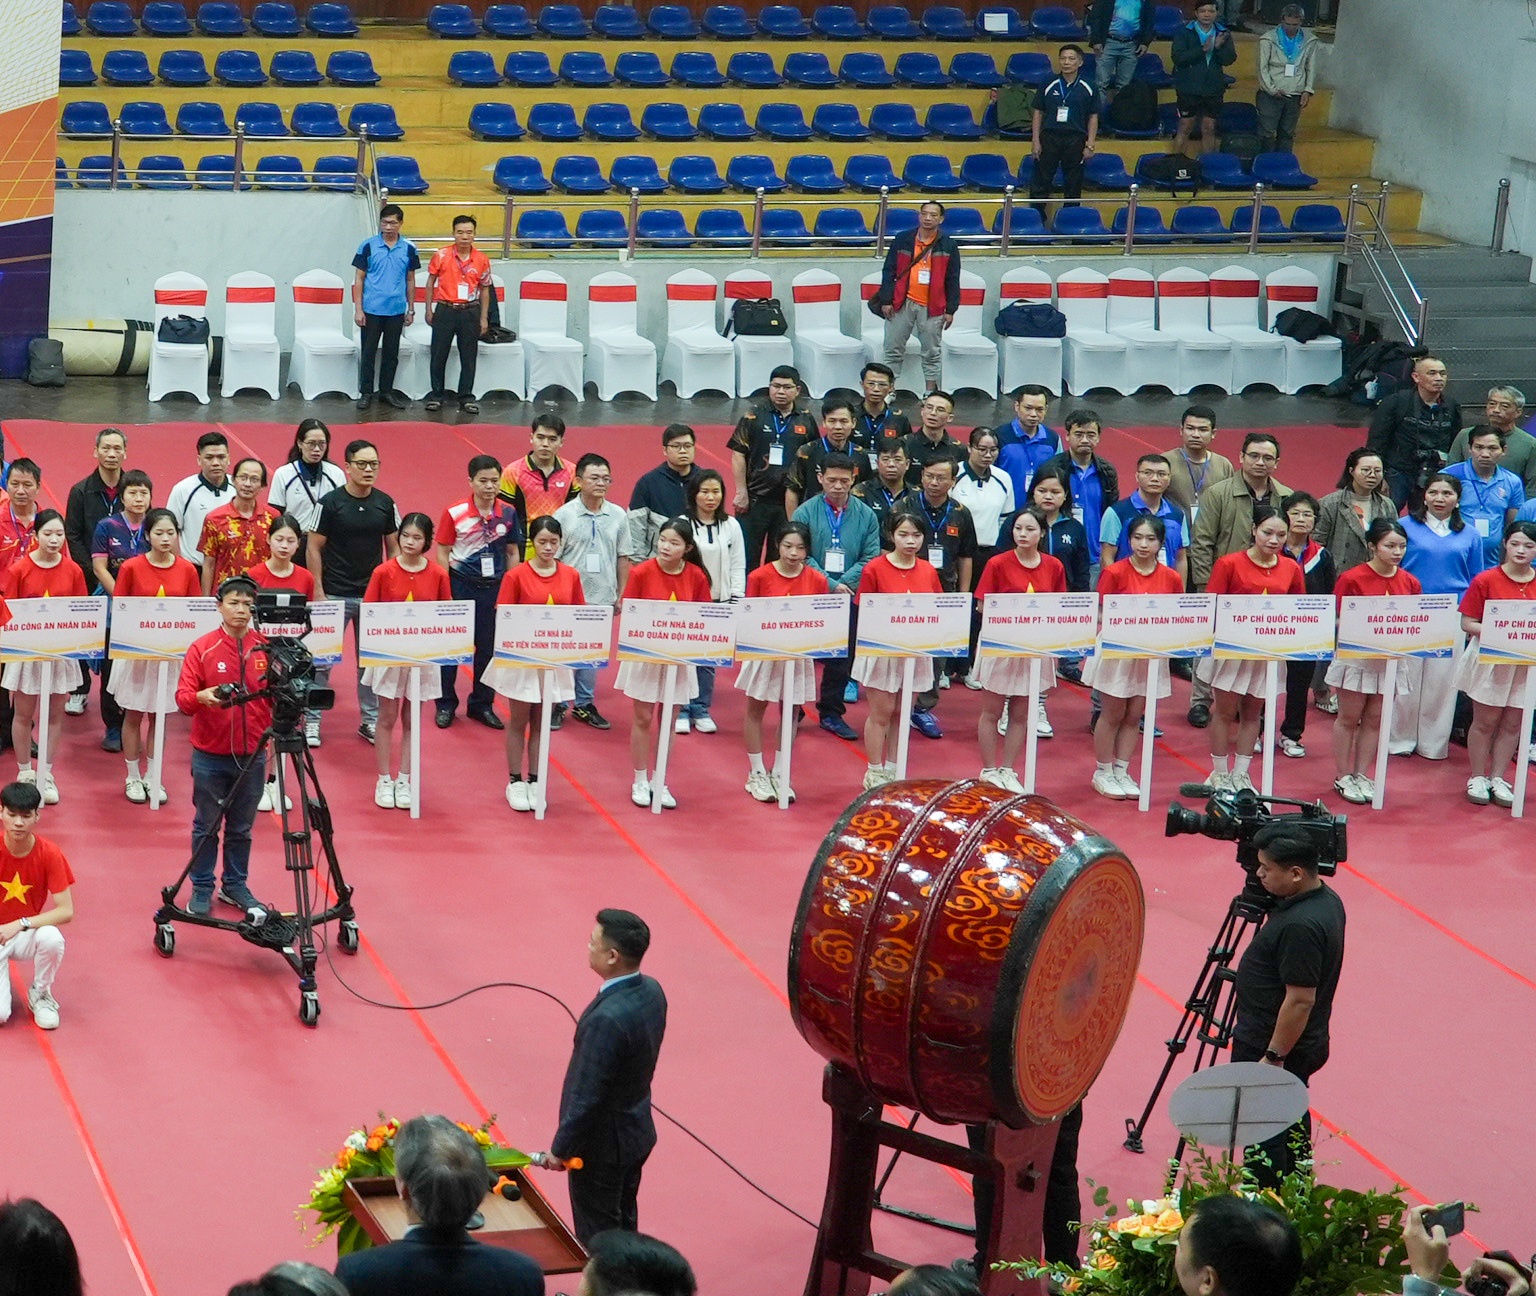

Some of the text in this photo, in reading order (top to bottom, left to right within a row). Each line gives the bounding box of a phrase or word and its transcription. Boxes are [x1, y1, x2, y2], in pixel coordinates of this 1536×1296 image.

[890, 615, 939, 624] BÁO DÂN TRÍ
[988, 615, 1092, 626] TRUNG TÂM PT- TH QUÂN ĐỘI
[1109, 615, 1208, 627] TẠP CHÍ AN TOÀN THÔNG TIN
[1232, 613, 1319, 626] TẠP CHÍ QUỐC PHÒNG
[1367, 613, 1429, 623] BÁO CÔNG GIÁO
[3, 620, 98, 632] BÁO CÔNG AN NHÂN DÂN
[140, 621, 156, 629] BÁO
[174, 620, 196, 630] ĐỘNG
[652, 619, 705, 629] LCH NHÀ BÁO
[761, 620, 824, 630] BÁO VNEXPRESS
[367, 625, 467, 636] LCH NHÀ BÁO NGÂN HÀNG
[628, 629, 728, 643] BÁO QUÂN ĐỘI NHÂN DÂN
[1255, 625, 1296, 636] TOÀN DÂN
[1374, 624, 1421, 637] VÀ DÂN TỘC
